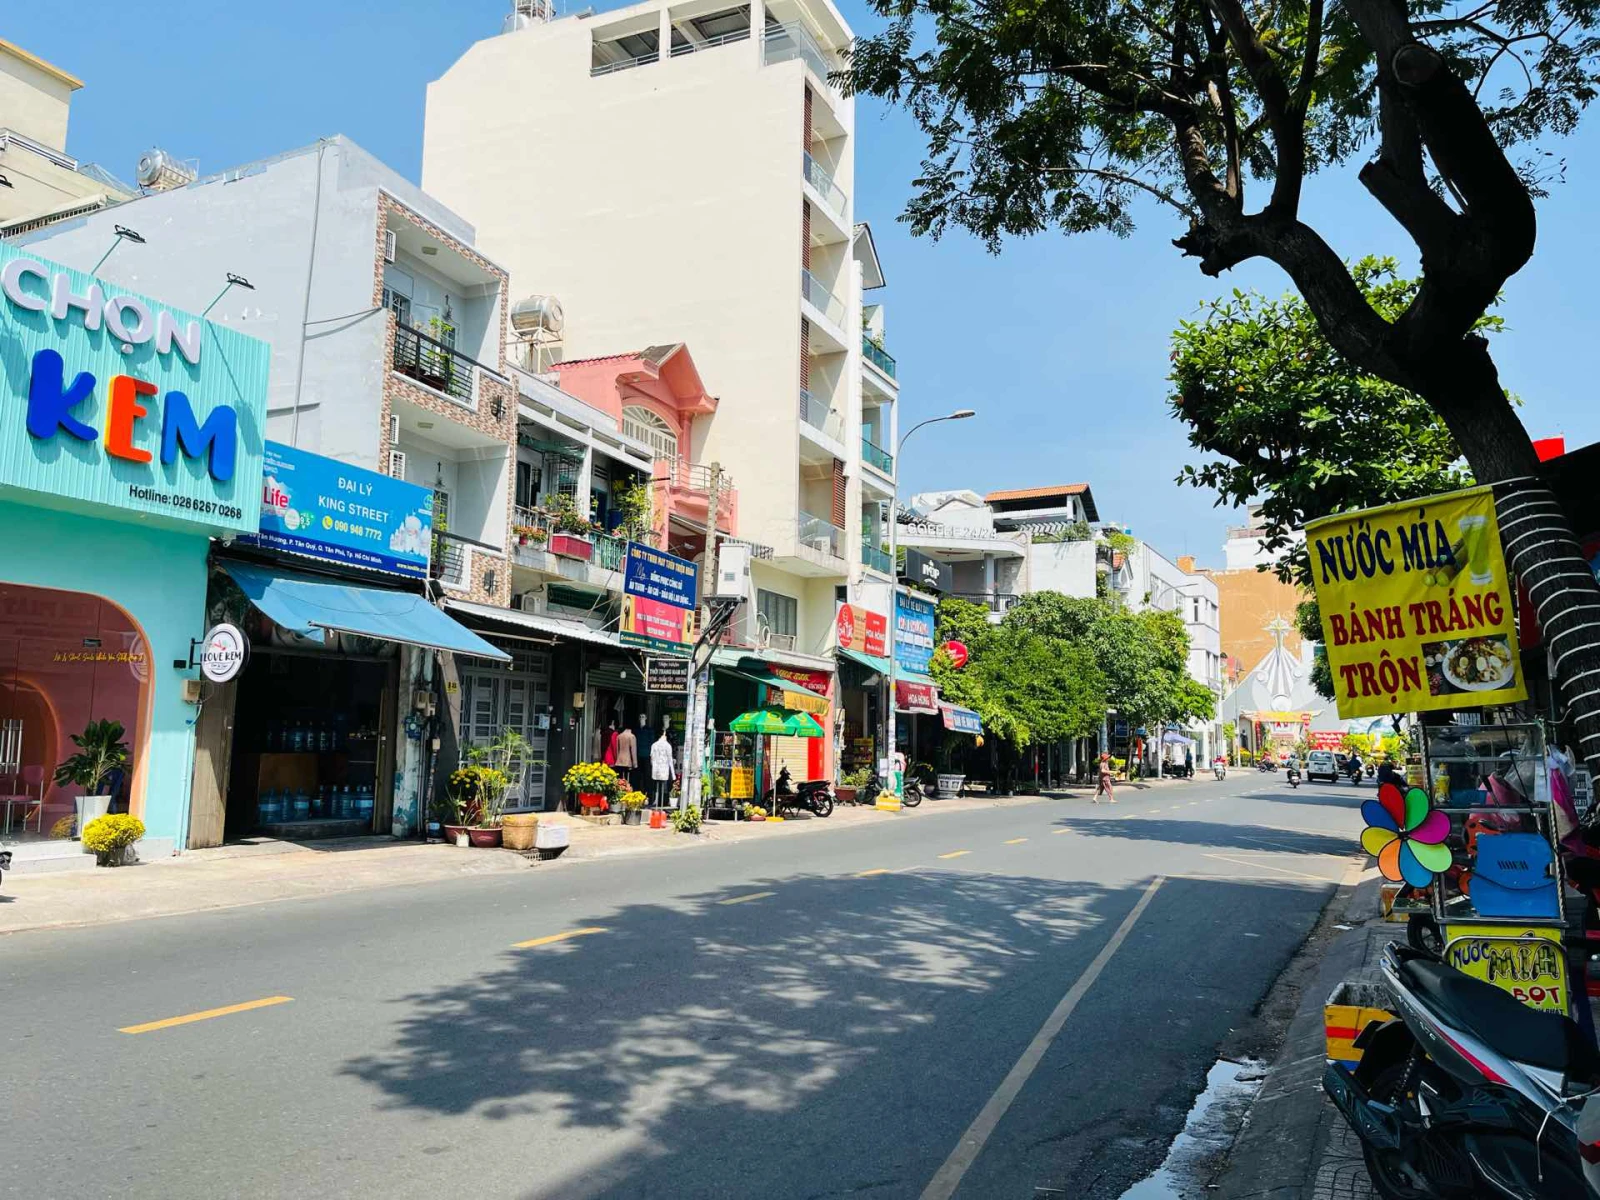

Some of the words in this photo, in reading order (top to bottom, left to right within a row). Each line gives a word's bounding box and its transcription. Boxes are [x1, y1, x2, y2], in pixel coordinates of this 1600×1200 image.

[1, 259, 201, 364] CHỌN
[26, 349, 237, 481] KEM
[129, 485, 172, 505] Hotline:
[173, 494, 191, 509] 028
[193, 498, 217, 514] 6267
[218, 504, 242, 519] 0268
[263, 486, 288, 508] Life
[338, 477, 357, 494] ĐẠI
[359, 483, 373, 496] LÝ
[318, 495, 346, 512] KING
[348, 502, 389, 523] STREET
[334, 520, 348, 533] 090
[365, 527, 382, 541] 7772
[1315, 519, 1396, 585] NƯỚC
[1396, 507, 1456, 573] MÍA
[1329, 602, 1406, 647] BÁNH
[1409, 588, 1505, 636] TRÁNG
[203, 652, 223, 662] LOVE
[225, 651, 241, 661] KEM
[1339, 649, 1422, 704] TRỘN
[1512, 986, 1560, 1005] BỌT
